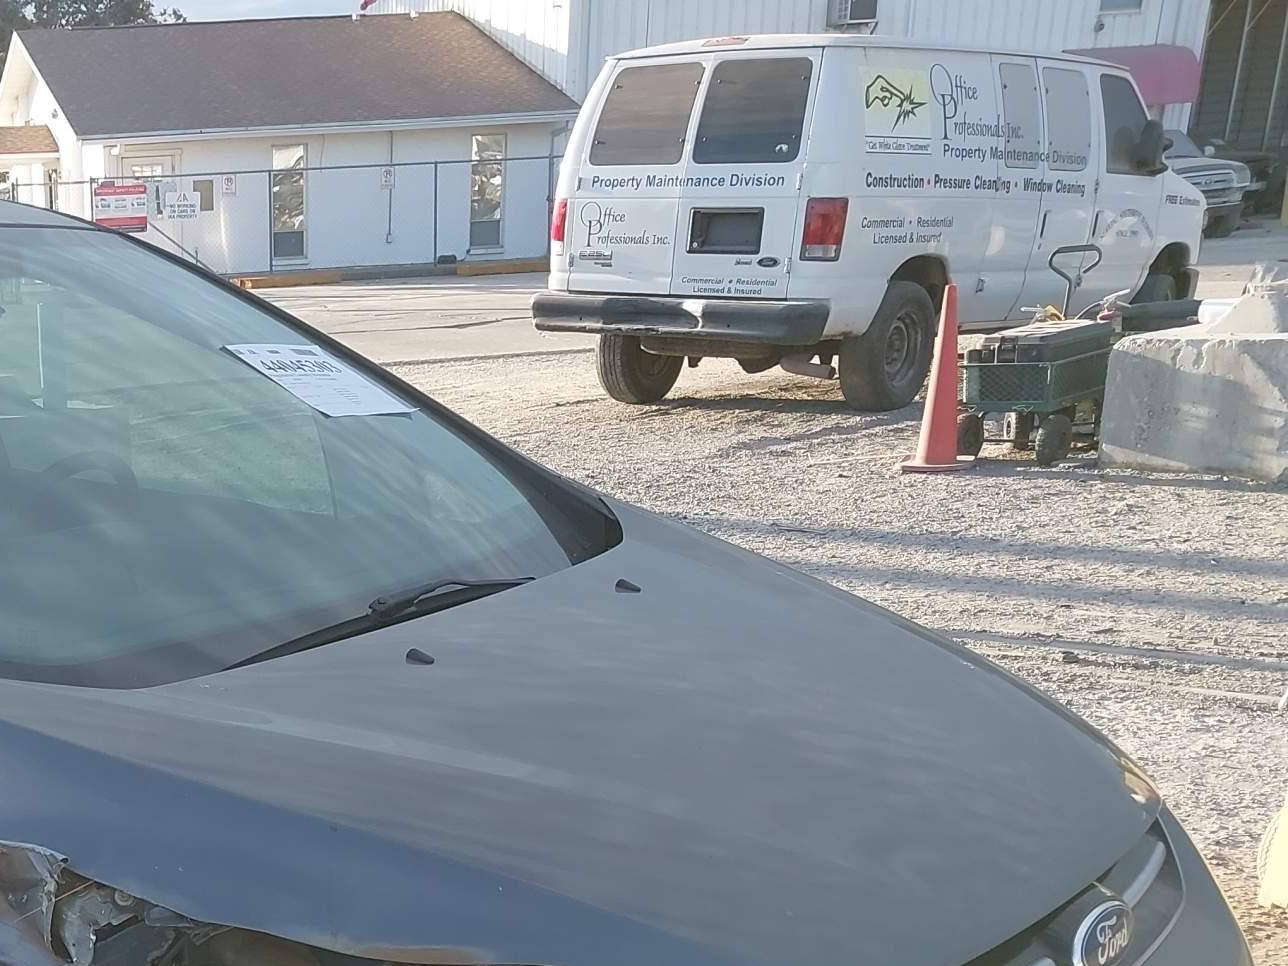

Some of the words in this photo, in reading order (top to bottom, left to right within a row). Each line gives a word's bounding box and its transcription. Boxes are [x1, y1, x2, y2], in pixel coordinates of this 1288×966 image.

[930, 64, 978, 106] Office
[940, 94, 1005, 143] Professionals
[1006, 122, 1024, 139] Inc.
[943, 144, 986, 162] Property
[990, 146, 1050, 162] Maintenance
[1052, 150, 1087, 166] Division
[592, 175, 642, 190] Property
[645, 174, 726, 188] Maintenance
[729, 172, 785, 187] Division
[865, 172, 925, 190] Construction
[934, 174, 971, 190] Pressure
[974, 175, 1011, 194] Cleaning
[1023, 177, 1053, 194] Window
[1055, 179, 1085, 197] Cleaning
[580, 202, 626, 227] Office
[861, 216, 905, 229] Commercial
[916, 216, 954, 228] Residential
[586, 220, 650, 248] Professionals
[652, 234, 671, 245] Inc.
[873, 232, 908, 244] Licensed
[908, 232, 914, 244] &
[916, 232, 942, 244] Insured
[681, 276, 724, 286] Commercial
[736, 278, 778, 287] Residential
[692, 286, 726, 295] Licensed
[726, 287, 732, 295] &
[734, 288, 762, 296] Insured
